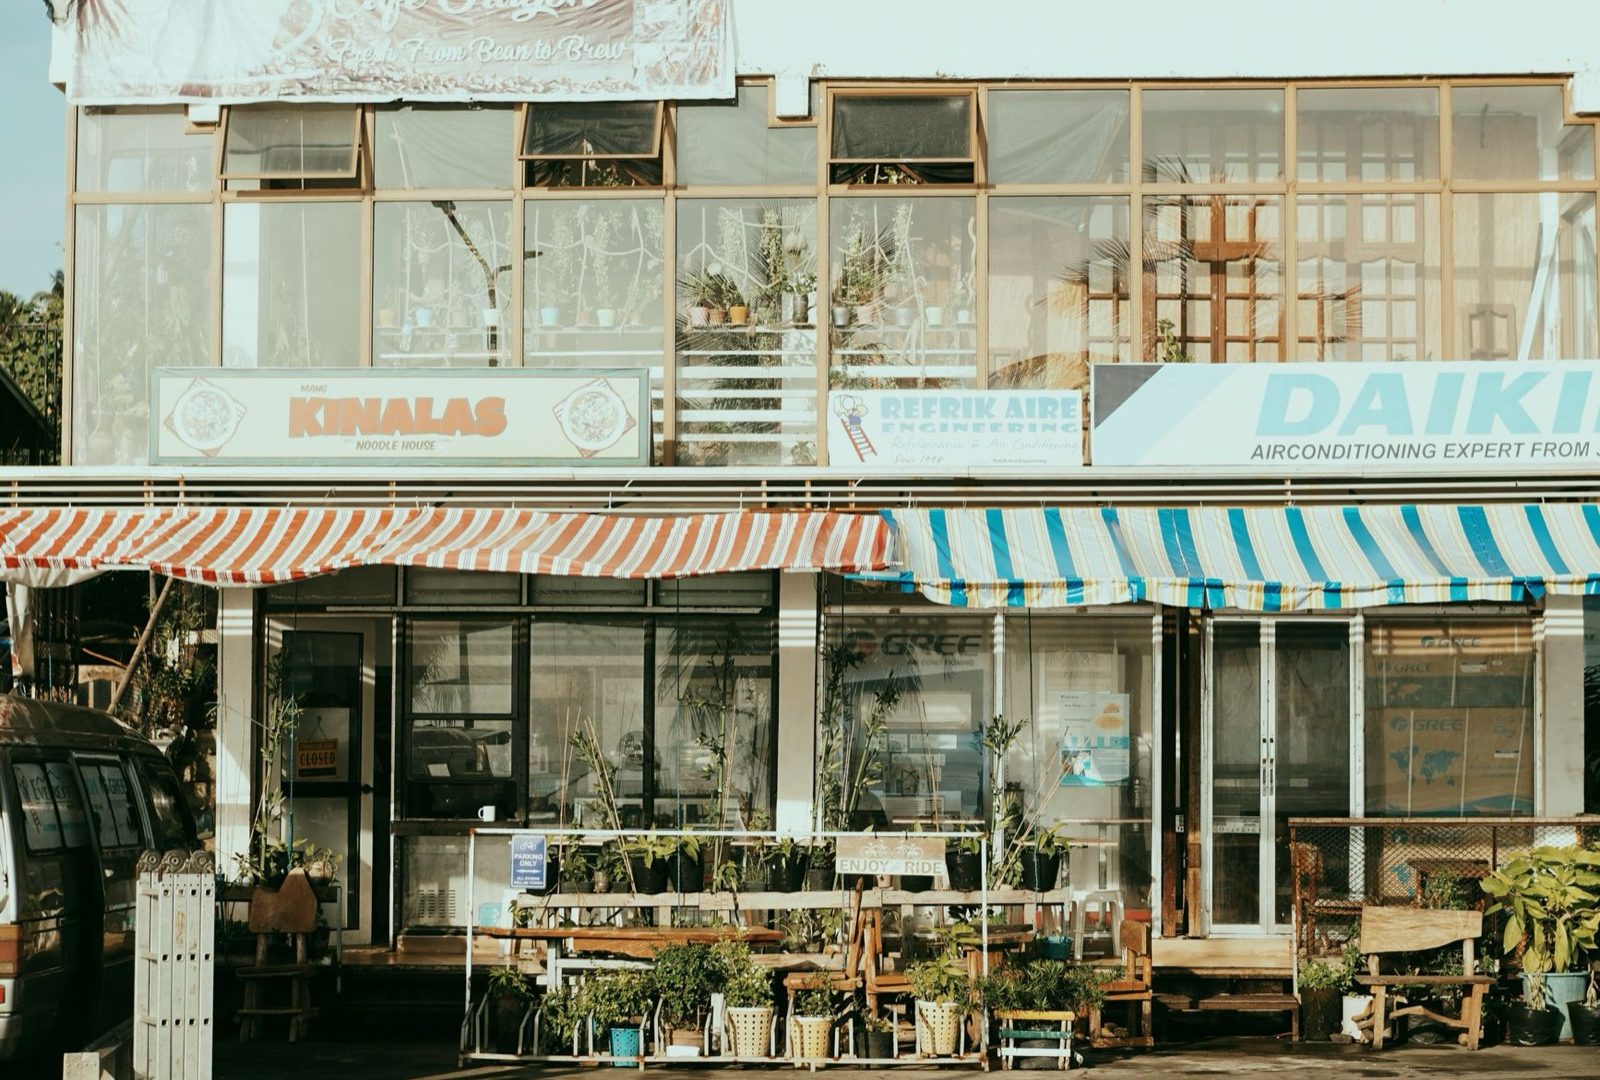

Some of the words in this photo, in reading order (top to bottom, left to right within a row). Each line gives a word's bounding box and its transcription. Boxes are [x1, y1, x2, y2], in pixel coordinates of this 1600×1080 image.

[401, 38, 468, 63] From
[468, 37, 531, 62] Bean
[533, 39, 556, 61] to
[558, 35, 628, 61] Brew
[880, 396, 996, 419] REFRIK
[1005, 396, 1078, 419] AIRE
[1255, 371, 1600, 436] DAIKI
[288, 396, 508, 438] KINALAS
[881, 422, 1078, 433] ENGINEERING
[356, 440, 398, 450] NOODLE
[401, 440, 437, 450] HOUSE
[1250, 443, 1436, 460] AIRCONDITIONING
[1443, 443, 1525, 458] EXPERT
[1530, 441, 1590, 457] FROM
[880, 634, 983, 656] GREE
[1393, 662, 1435, 673] GREE
[1412, 719, 1464, 731] GREE
[300, 752, 336, 767] CLOSED
[513, 853, 544, 861] PARKING
[840, 859, 889, 873] ENJOY
[904, 861, 942, 874] RIDE
